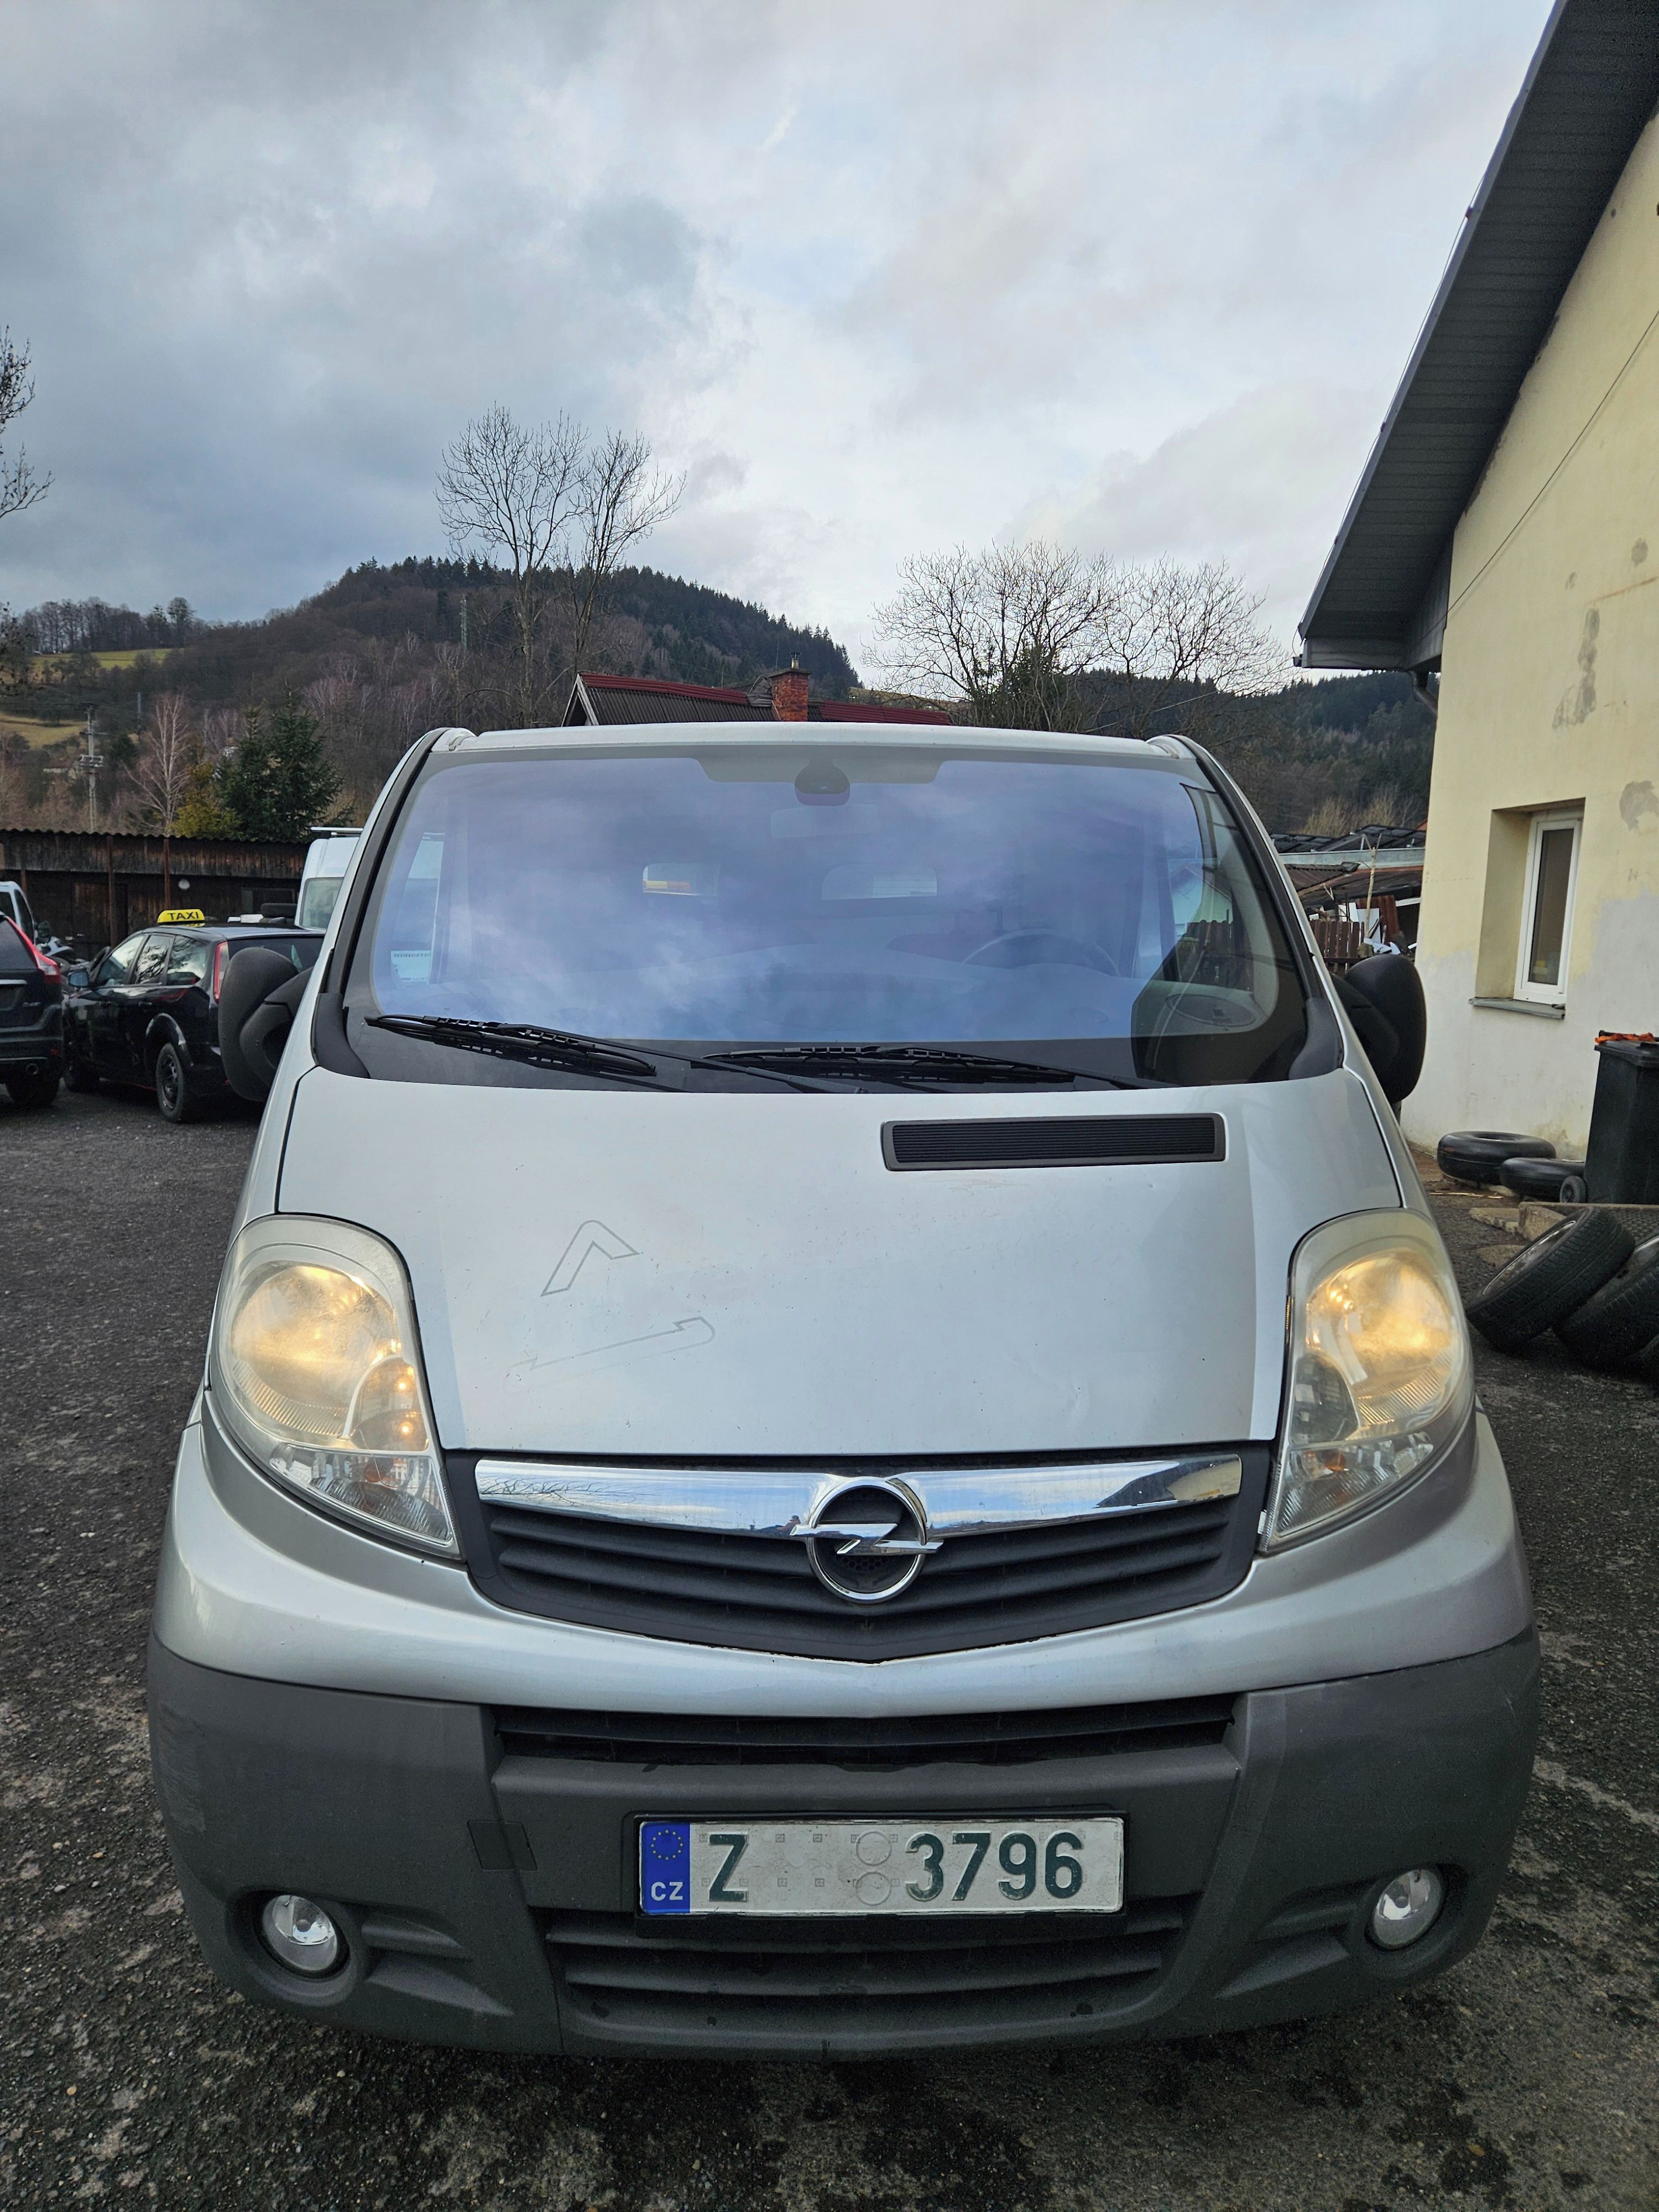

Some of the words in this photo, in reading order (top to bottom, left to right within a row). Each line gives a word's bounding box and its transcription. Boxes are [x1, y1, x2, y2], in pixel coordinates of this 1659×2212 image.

[167, 912, 199, 920] TAXI
[709, 1833, 748, 1901] Z
[906, 1831, 1083, 1901] 3796
[651, 1882, 683, 1901] CZ
